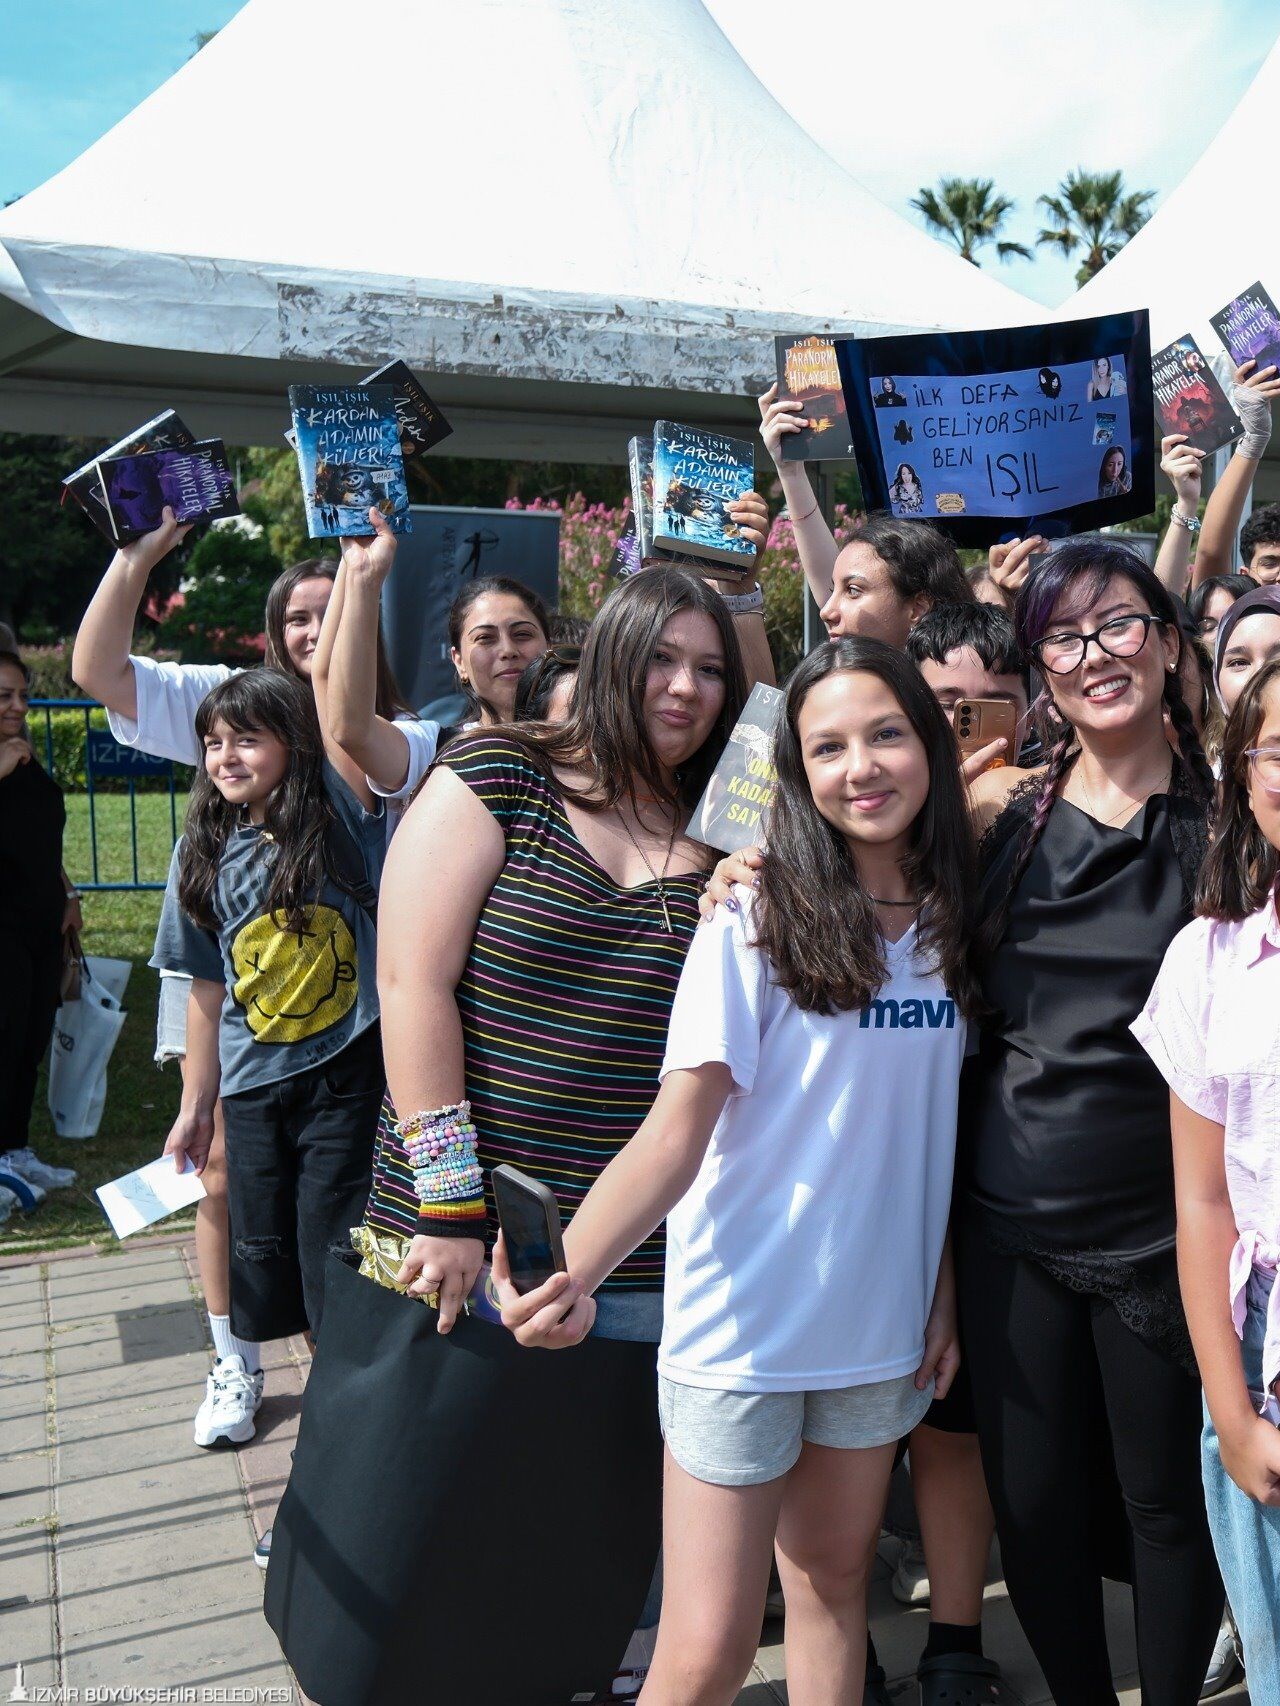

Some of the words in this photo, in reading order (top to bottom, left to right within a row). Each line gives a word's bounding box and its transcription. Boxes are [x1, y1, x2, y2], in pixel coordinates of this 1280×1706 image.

[1219, 297, 1268, 340] PARANORMAL
[1231, 312, 1279, 356] HİKAYELER
[912, 384, 943, 408] İLK
[961, 383, 1019, 405] DEFA
[306, 406, 380, 429] KARDAN
[922, 403, 1083, 439] GELİYORSANIZ
[319, 426, 383, 448] ADAMIN
[320, 444, 383, 465] KÜLLERİ
[666, 440, 738, 466] KARDAN
[199, 449, 224, 514] PARANORMAL
[674, 459, 740, 482] ADAMIN
[932, 446, 973, 468] BEN
[986, 452, 1059, 502] IŞIL
[168, 456, 202, 518] HİKAYELER
[677, 474, 739, 500] KÜLLERİ
[859, 989, 956, 1029] mavi
